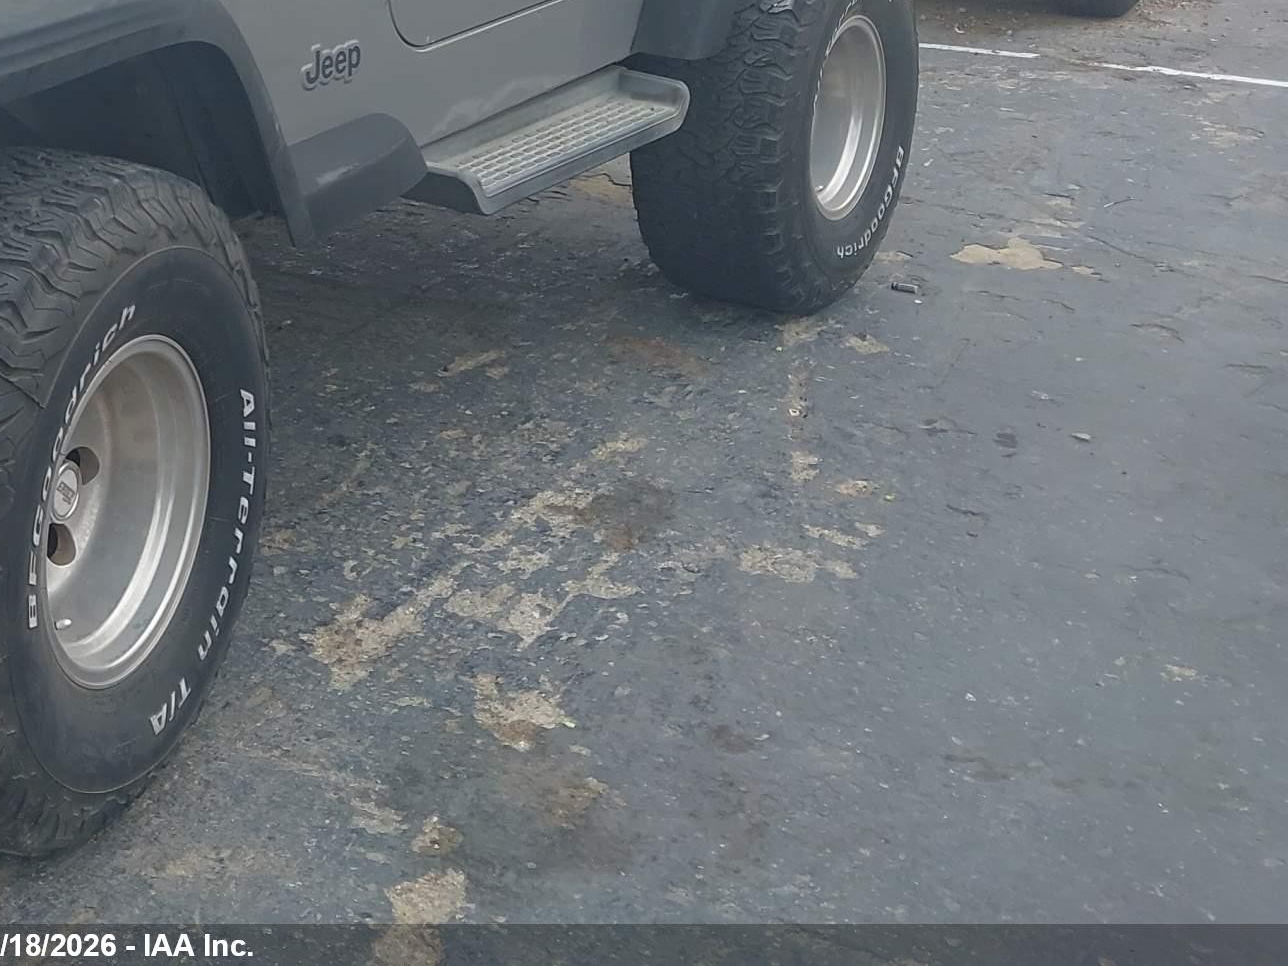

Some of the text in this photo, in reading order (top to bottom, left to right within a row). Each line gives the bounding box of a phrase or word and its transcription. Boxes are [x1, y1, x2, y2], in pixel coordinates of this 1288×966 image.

[303, 42, 361, 88] Jeep
[835, 144, 905, 260] BFGoodrich
[27, 303, 136, 630] BFGoodrich
[149, 388, 257, 736] All-Terrain T/A
